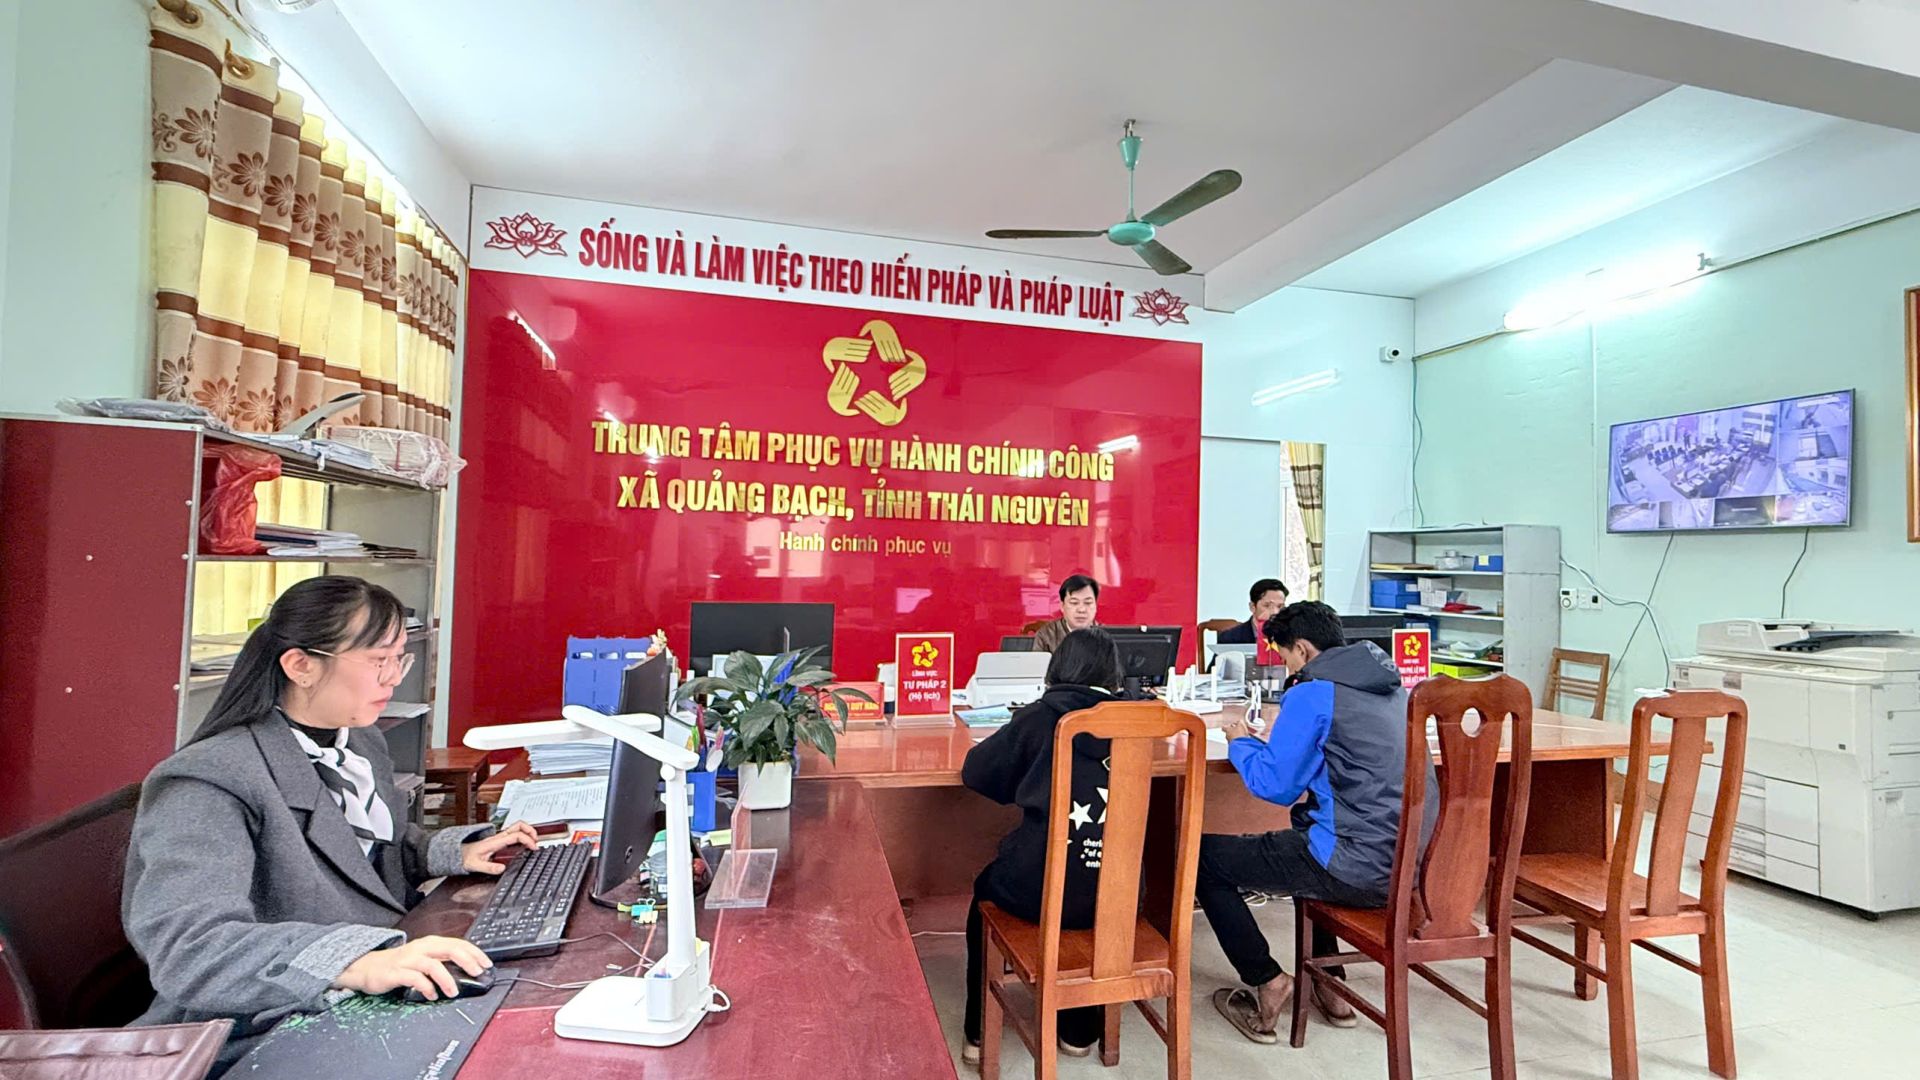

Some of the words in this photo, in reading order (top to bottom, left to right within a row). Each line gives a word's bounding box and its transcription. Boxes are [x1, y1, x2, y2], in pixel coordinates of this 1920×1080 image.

[579, 218, 649, 273] SỐNG
[656, 230, 687, 277] VÀ
[695, 235, 746, 283] LÀM
[753, 244, 805, 293] VIỆC
[809, 254, 862, 295] THEO
[871, 253, 922, 301] HIẾN
[927, 265, 983, 308] PHÁP
[988, 270, 1015, 311] VÀ
[1021, 275, 1073, 317] PHÁP
[1079, 281, 1125, 328] LUẬT
[592, 421, 691, 459] TRUNG
[699, 422, 760, 462] TÂM
[767, 433, 841, 472] PHỤC
[849, 437, 884, 474] VỤ
[890, 434, 962, 473] HÀNH
[967, 440, 1045, 479] CHÍNH
[1048, 444, 1115, 481] CÔNG
[617, 469, 660, 510] XÃ
[667, 469, 766, 515] QUẢNG
[772, 483, 855, 522] BẠCH,
[862, 477, 923, 519] TỈNH
[927, 487, 984, 523] THÁI
[991, 491, 1089, 527] NGUYÊN
[780, 531, 824, 551] Hành
[831, 533, 878, 553] chính
[885, 538, 926, 558] phục
[932, 540, 951, 558] vụ
[916, 679, 940, 690] PHÁP
[940, 680, 947, 689] 2
